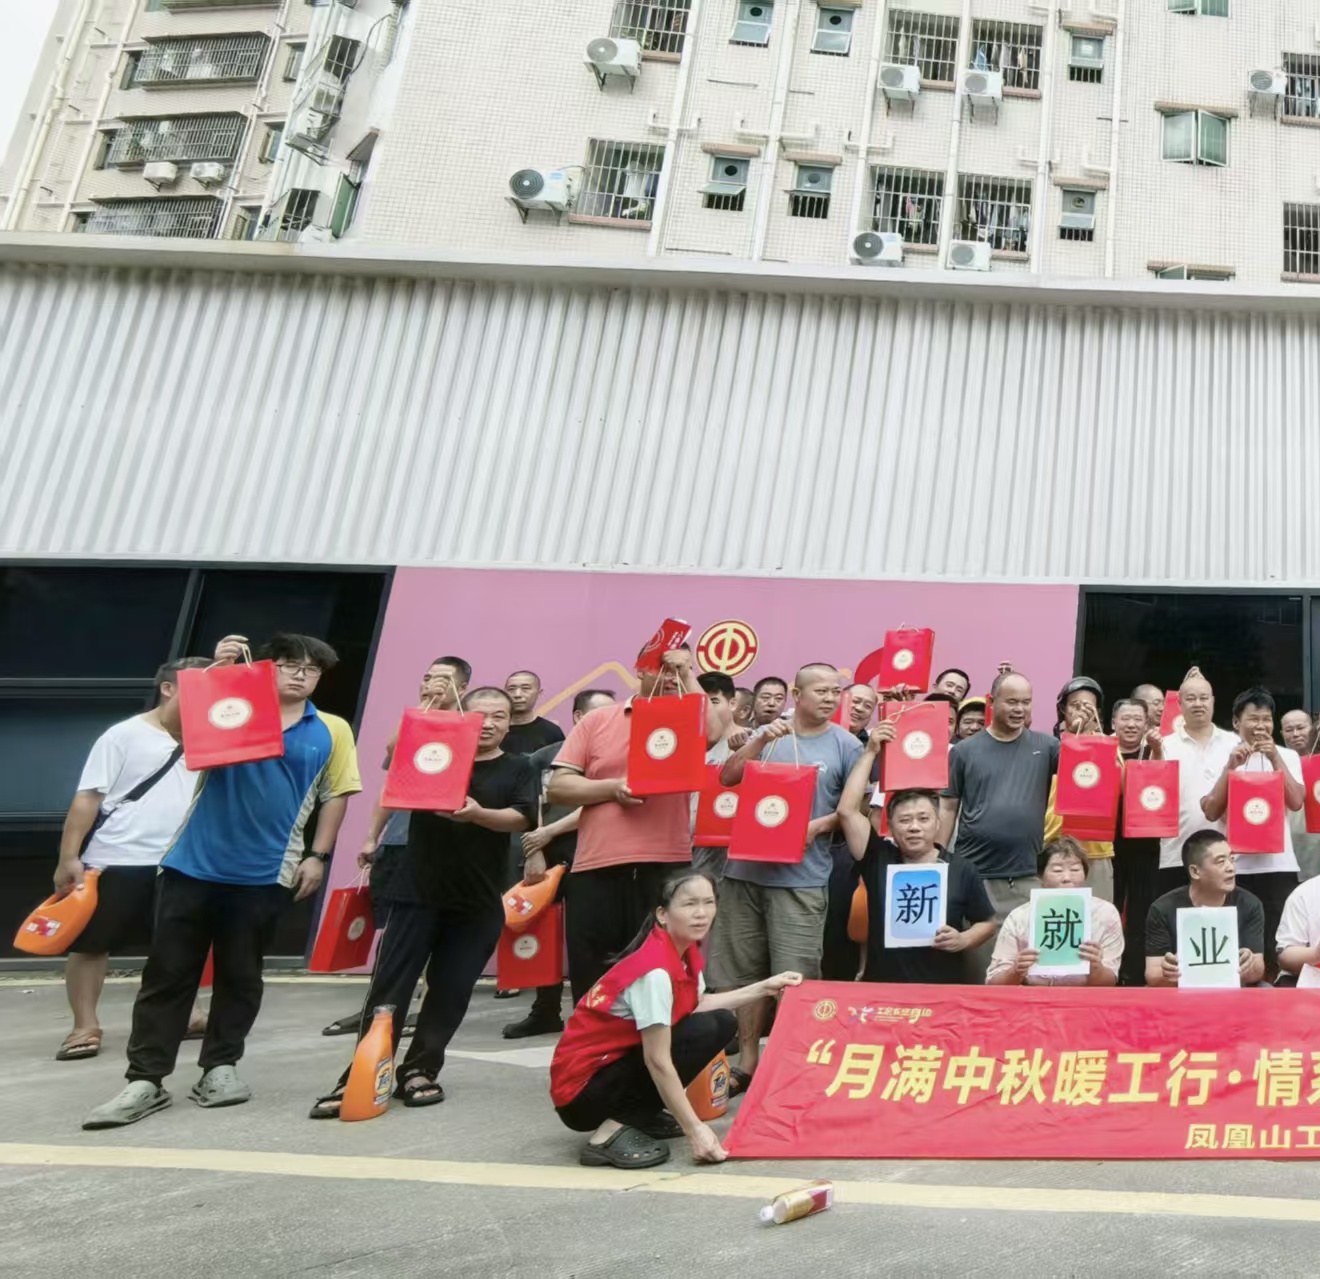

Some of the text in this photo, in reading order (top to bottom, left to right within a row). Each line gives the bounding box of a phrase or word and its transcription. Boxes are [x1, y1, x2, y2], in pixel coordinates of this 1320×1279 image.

[896, 883, 939, 925] 新
[1039, 908, 1082, 951] 就
[1188, 926, 1231, 968] 业
